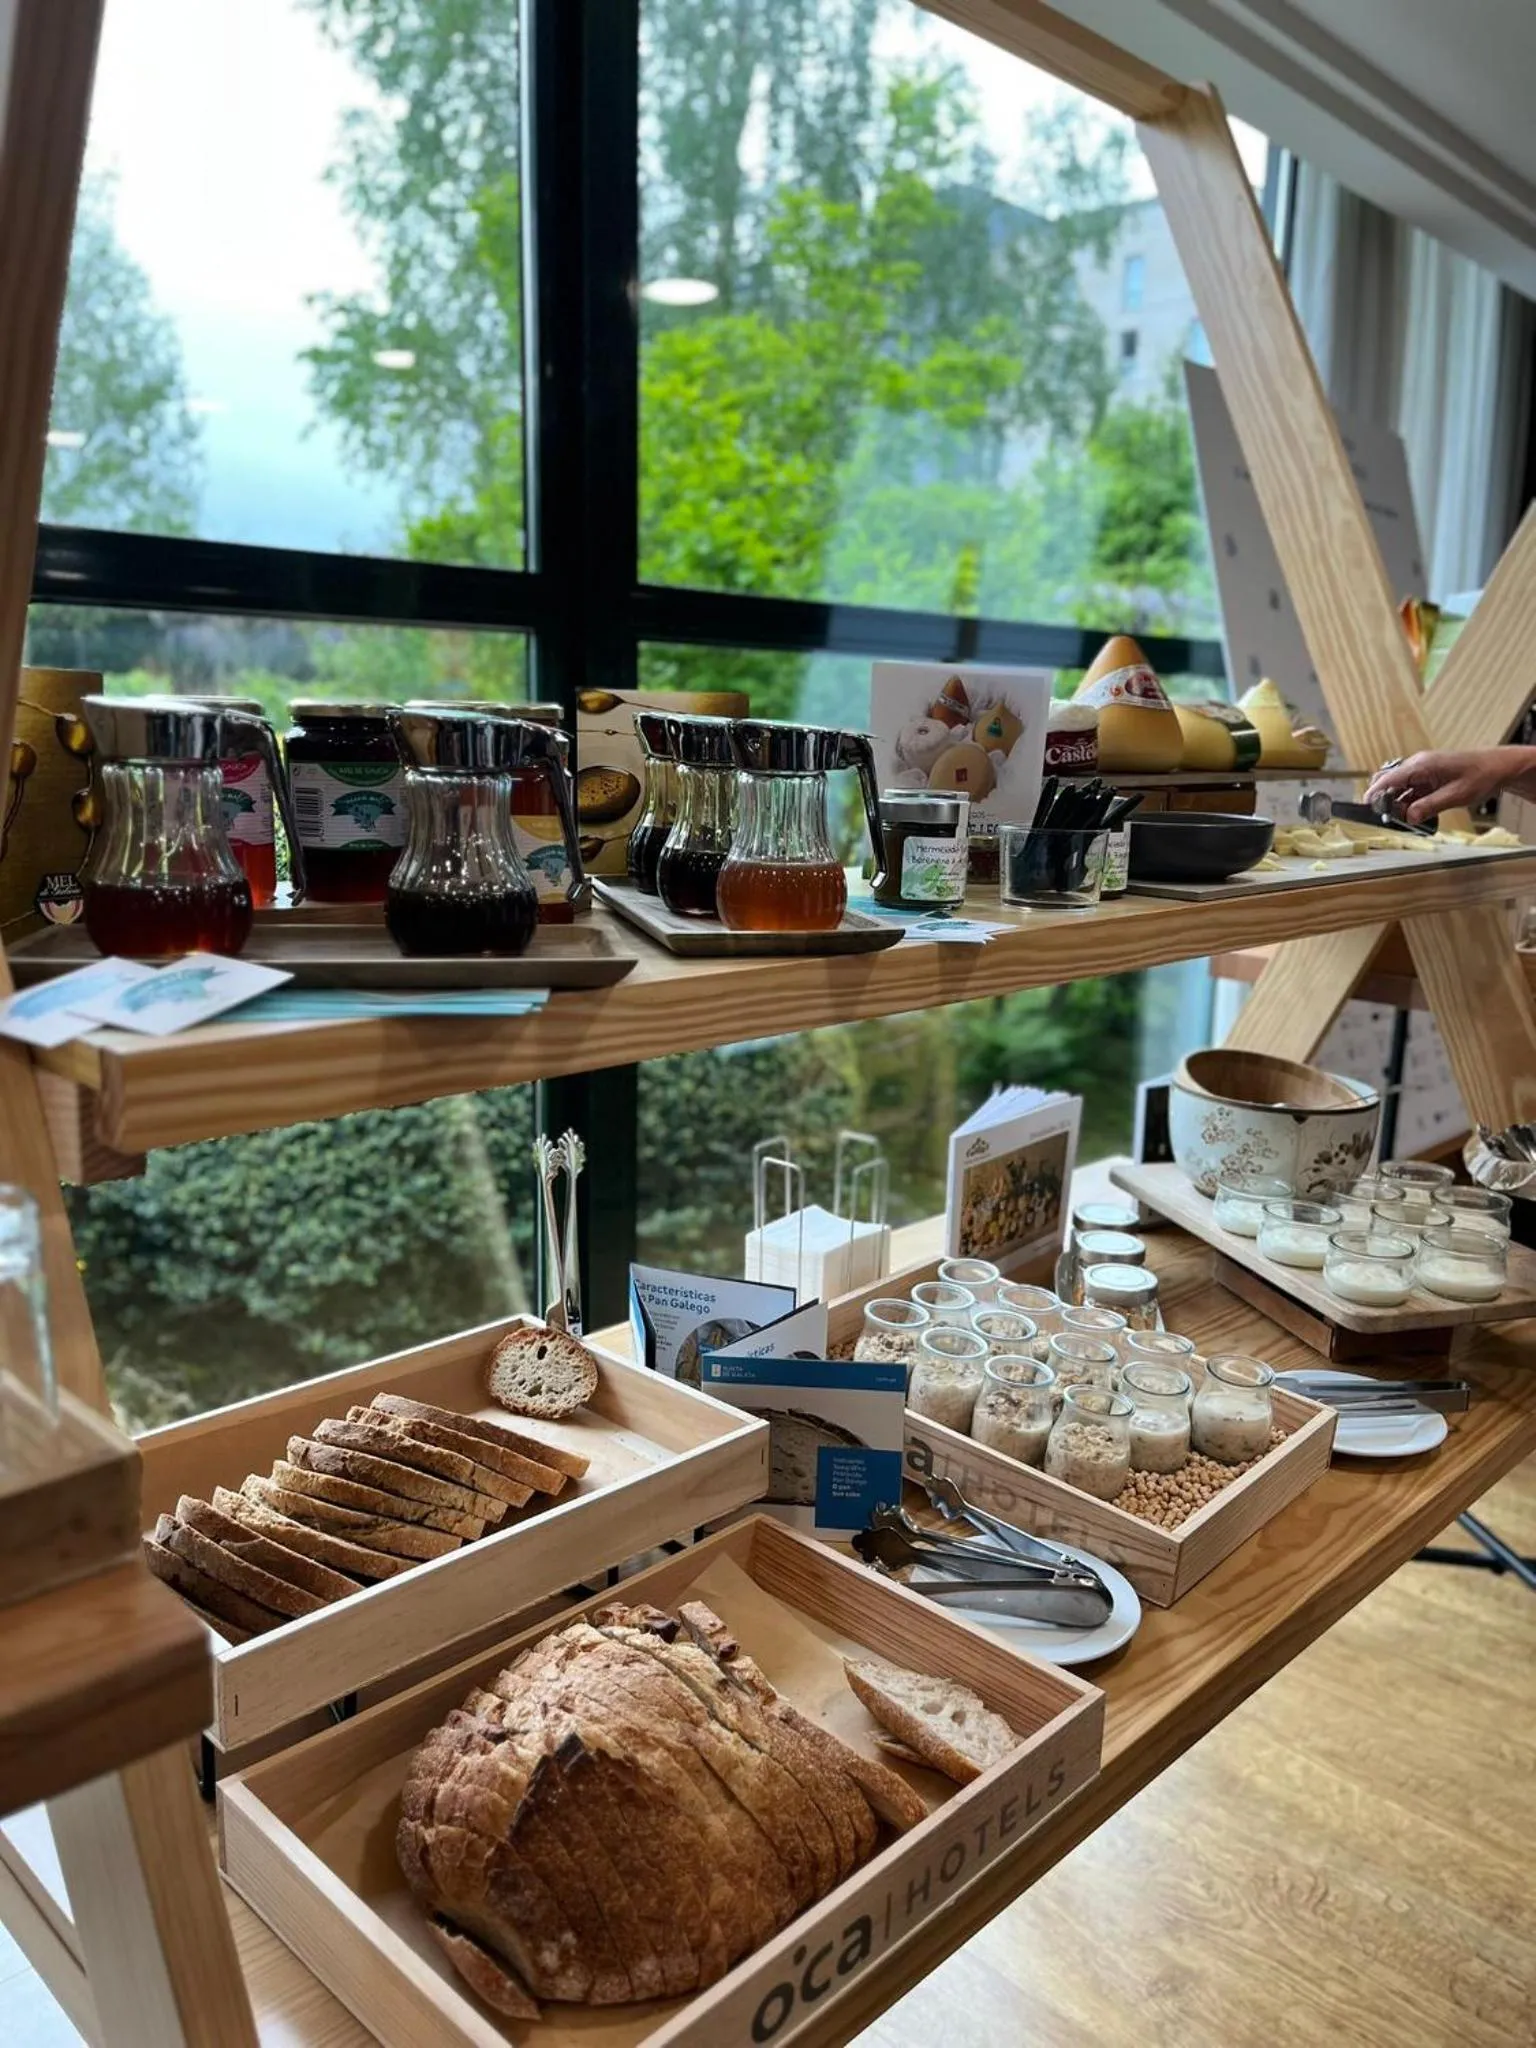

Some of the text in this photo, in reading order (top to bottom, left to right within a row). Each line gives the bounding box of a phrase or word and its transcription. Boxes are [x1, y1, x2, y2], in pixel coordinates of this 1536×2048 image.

[46, 875, 77, 889] MEL
[648, 1294, 668, 1306] Pan
[669, 1298, 711, 1315] Galego
[906, 1758, 1066, 1914] HOTELS
